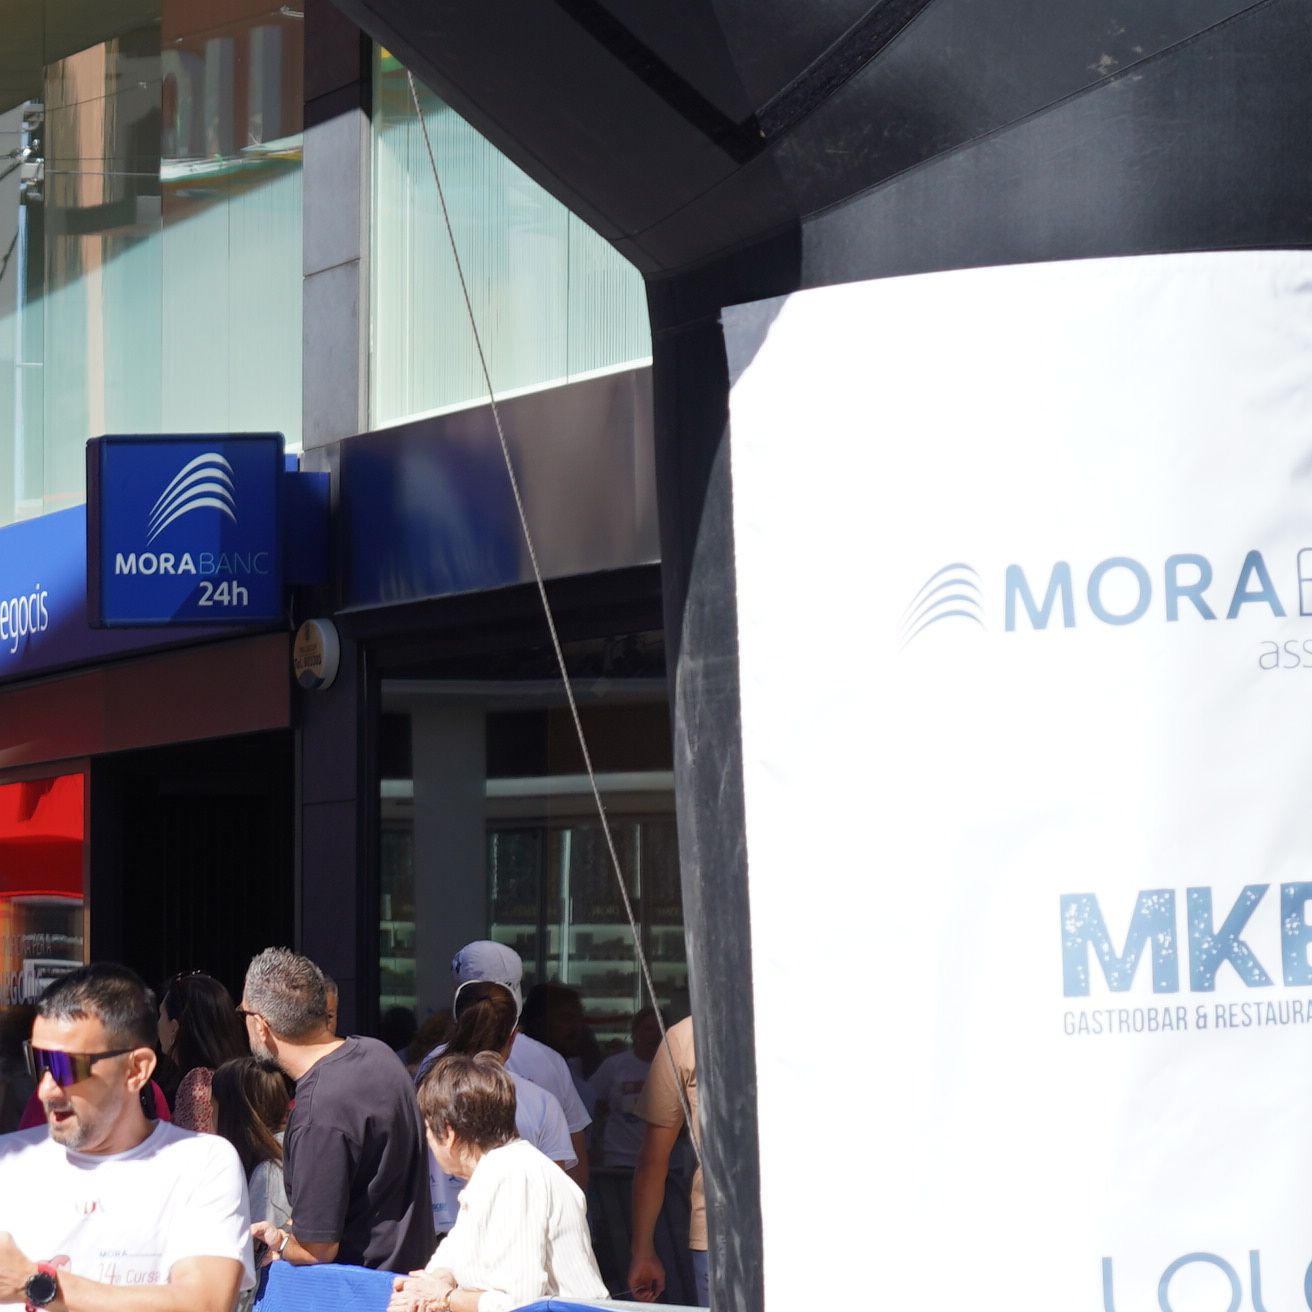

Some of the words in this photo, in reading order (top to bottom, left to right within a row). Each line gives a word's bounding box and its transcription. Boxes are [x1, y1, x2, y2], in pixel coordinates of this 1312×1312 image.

[198, 580, 249, 606] 24h
[1063, 1005, 1187, 1036] GASTROBAR
[1195, 1004, 1208, 1030] &
